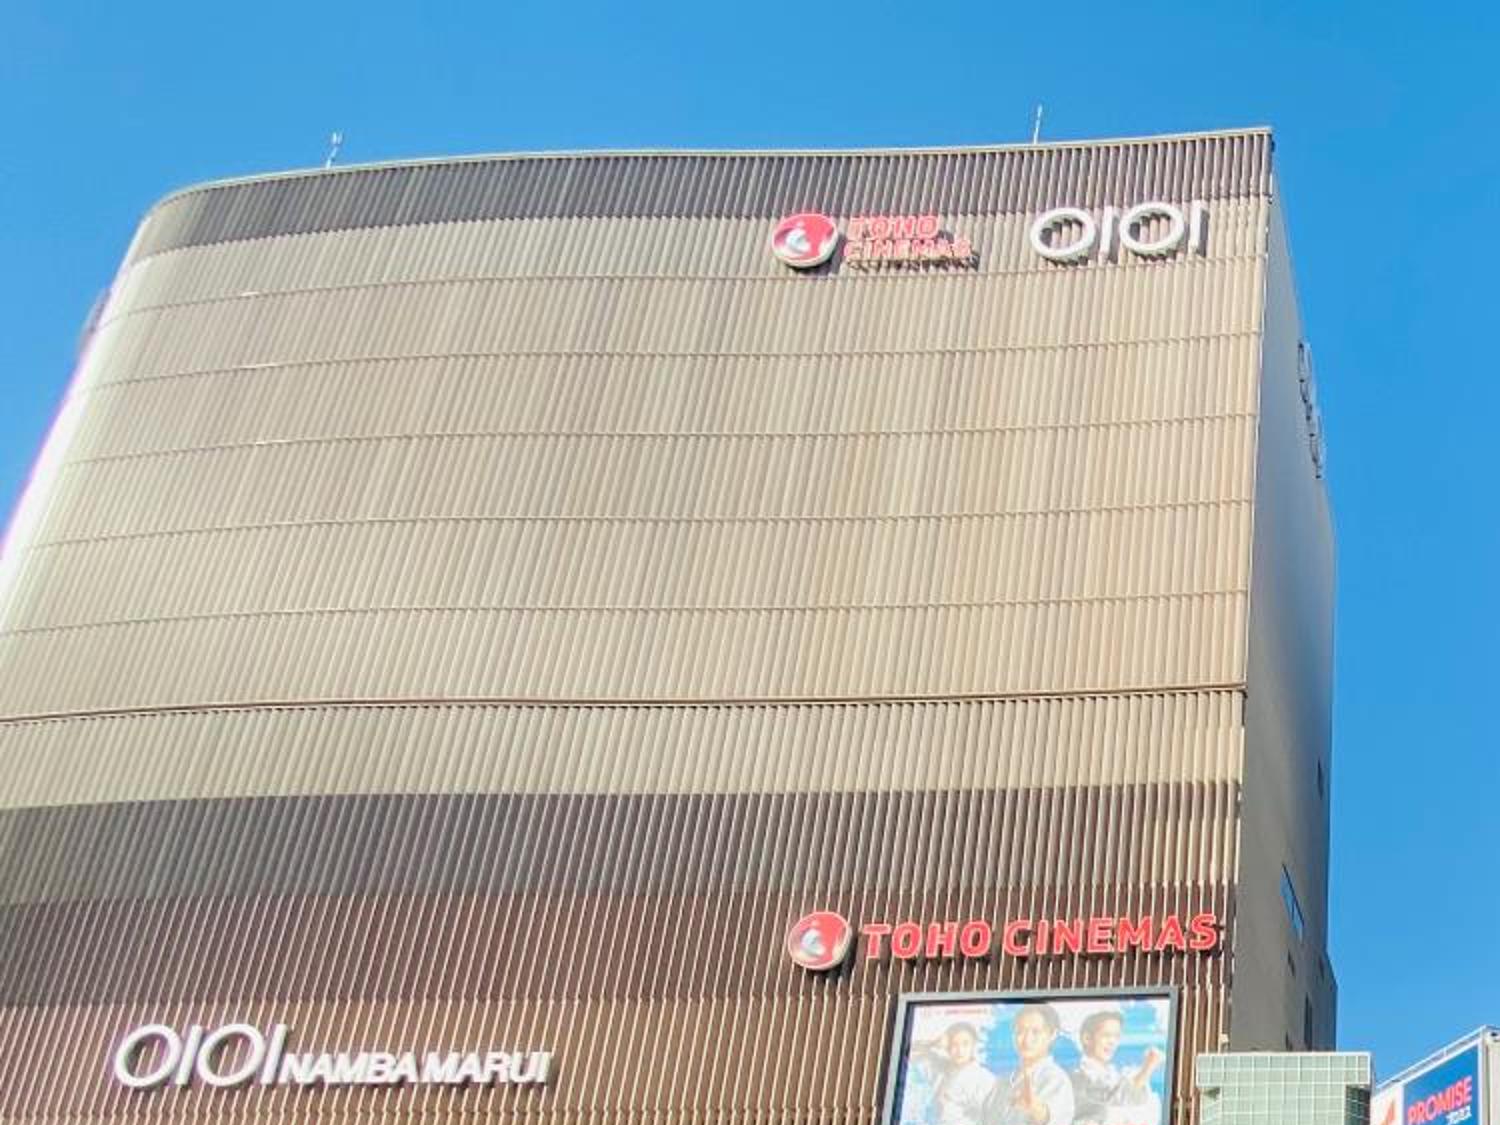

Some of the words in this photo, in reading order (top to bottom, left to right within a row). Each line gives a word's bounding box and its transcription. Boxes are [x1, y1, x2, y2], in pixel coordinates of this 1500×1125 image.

[863, 919, 991, 959] TOHO
[1003, 914, 1218, 957] CINEMAS
[277, 1052, 420, 1085] NAMBA
[419, 1050, 552, 1084] MARUI
